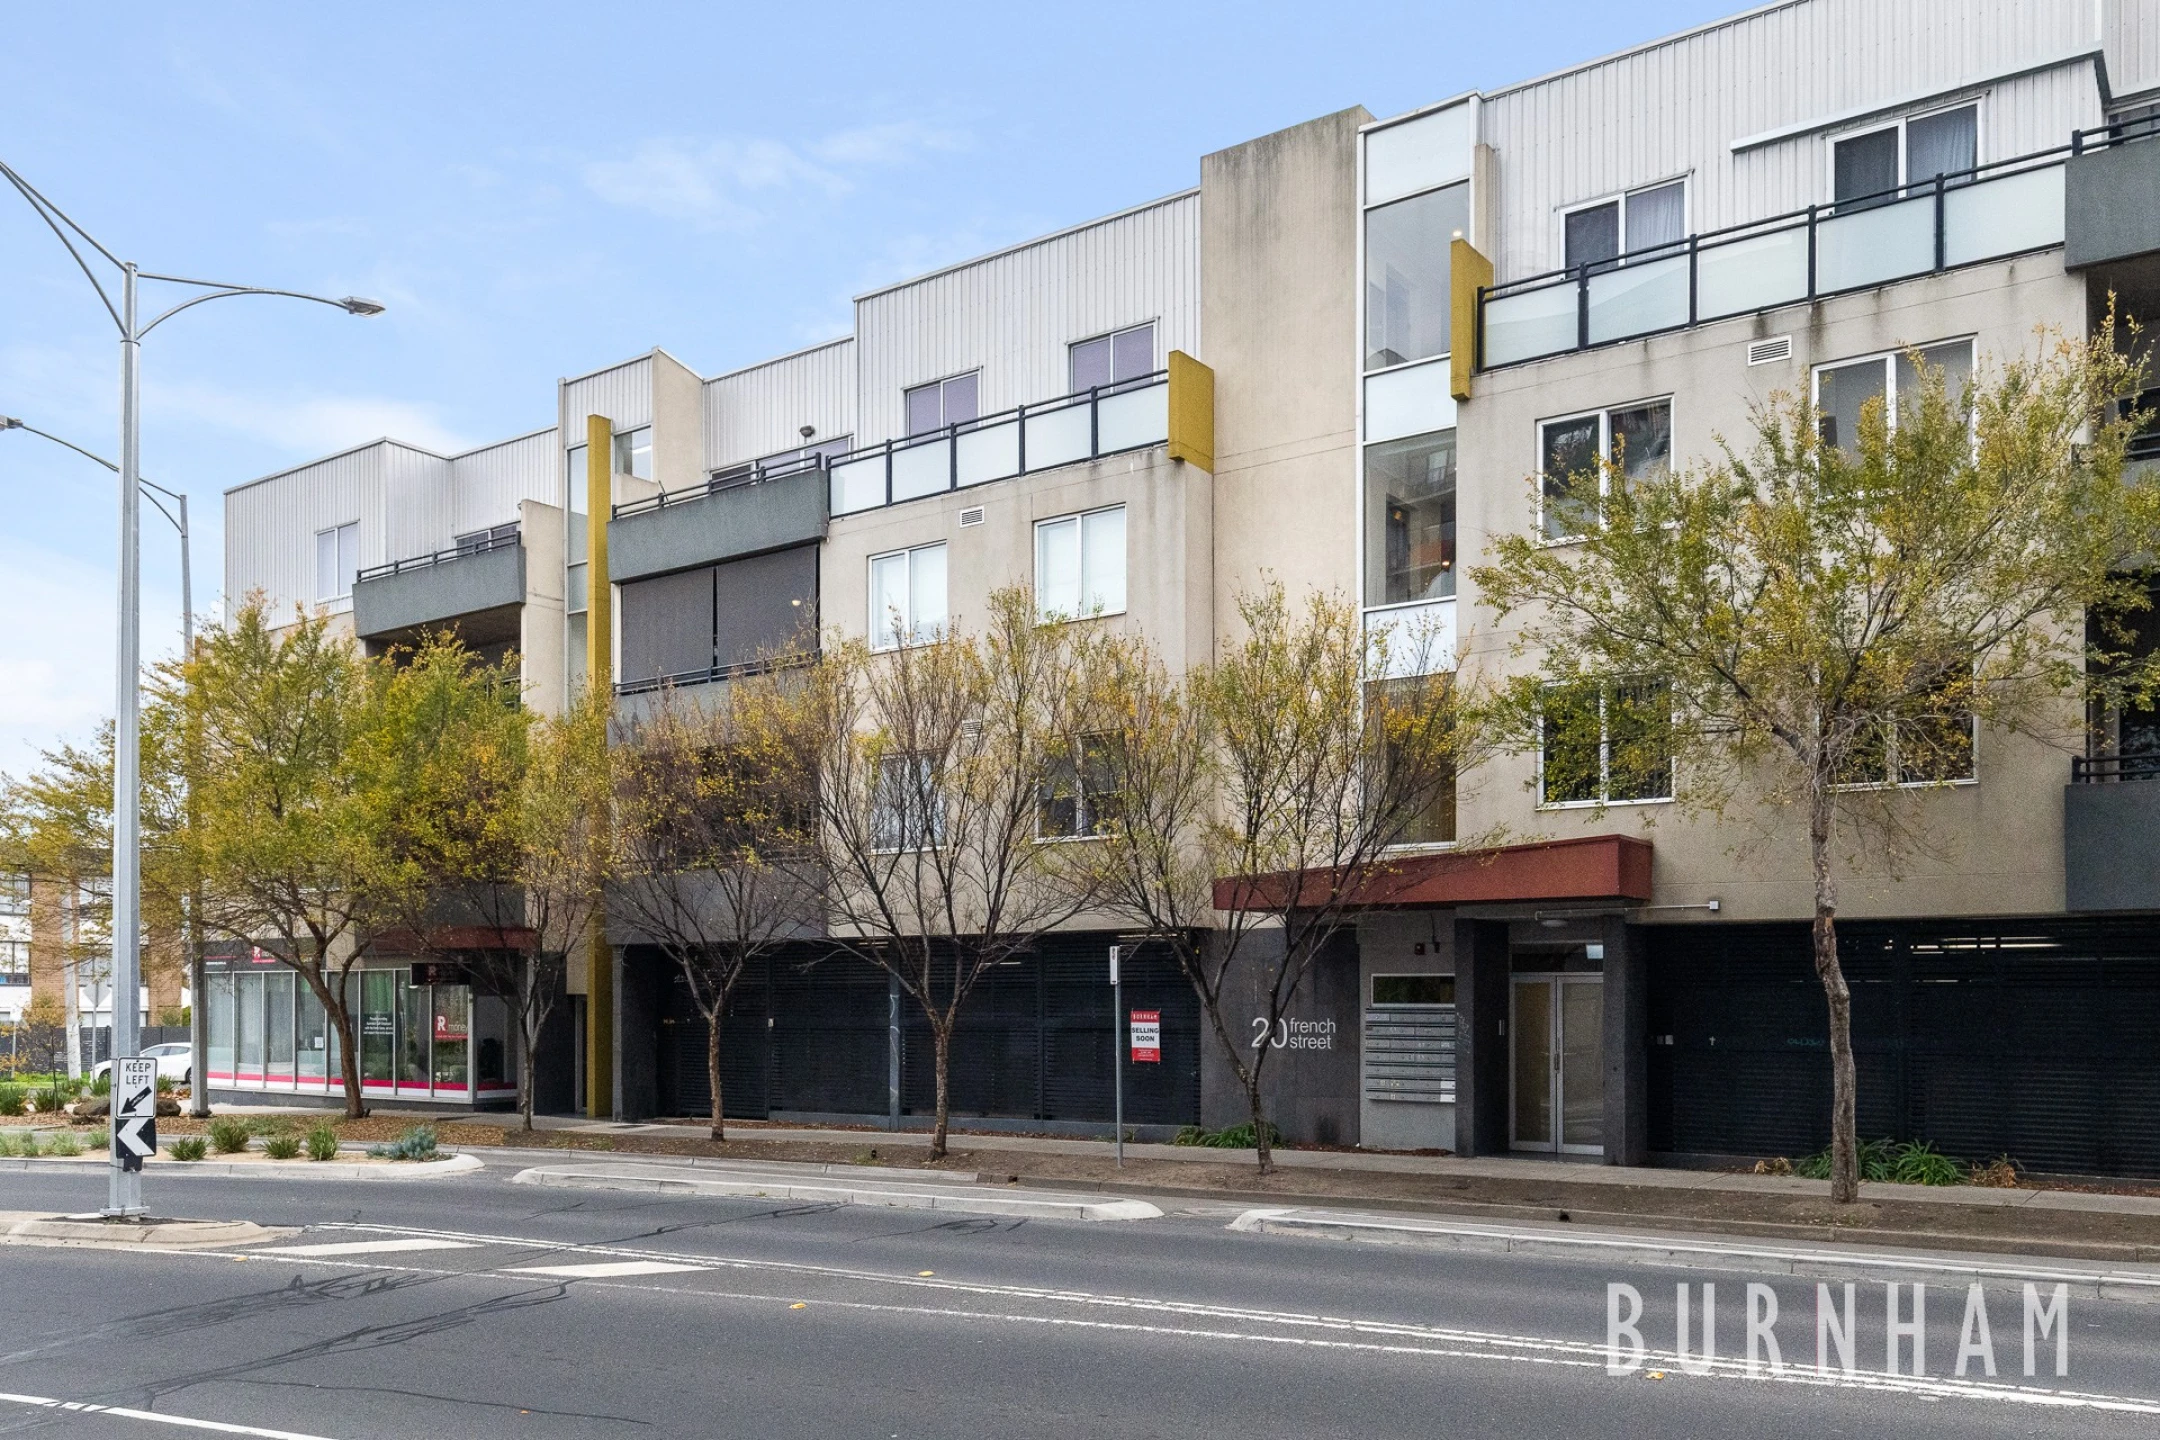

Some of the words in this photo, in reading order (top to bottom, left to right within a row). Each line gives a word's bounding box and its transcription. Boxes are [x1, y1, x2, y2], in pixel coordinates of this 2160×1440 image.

[437, 1015, 446, 1032] R
[1251, 1017, 1288, 1049] 20
[1289, 1017, 1336, 1034] french
[1289, 1034, 1332, 1050] street
[125, 1063, 151, 1073] KEEP
[126, 1075, 150, 1085] LEFT
